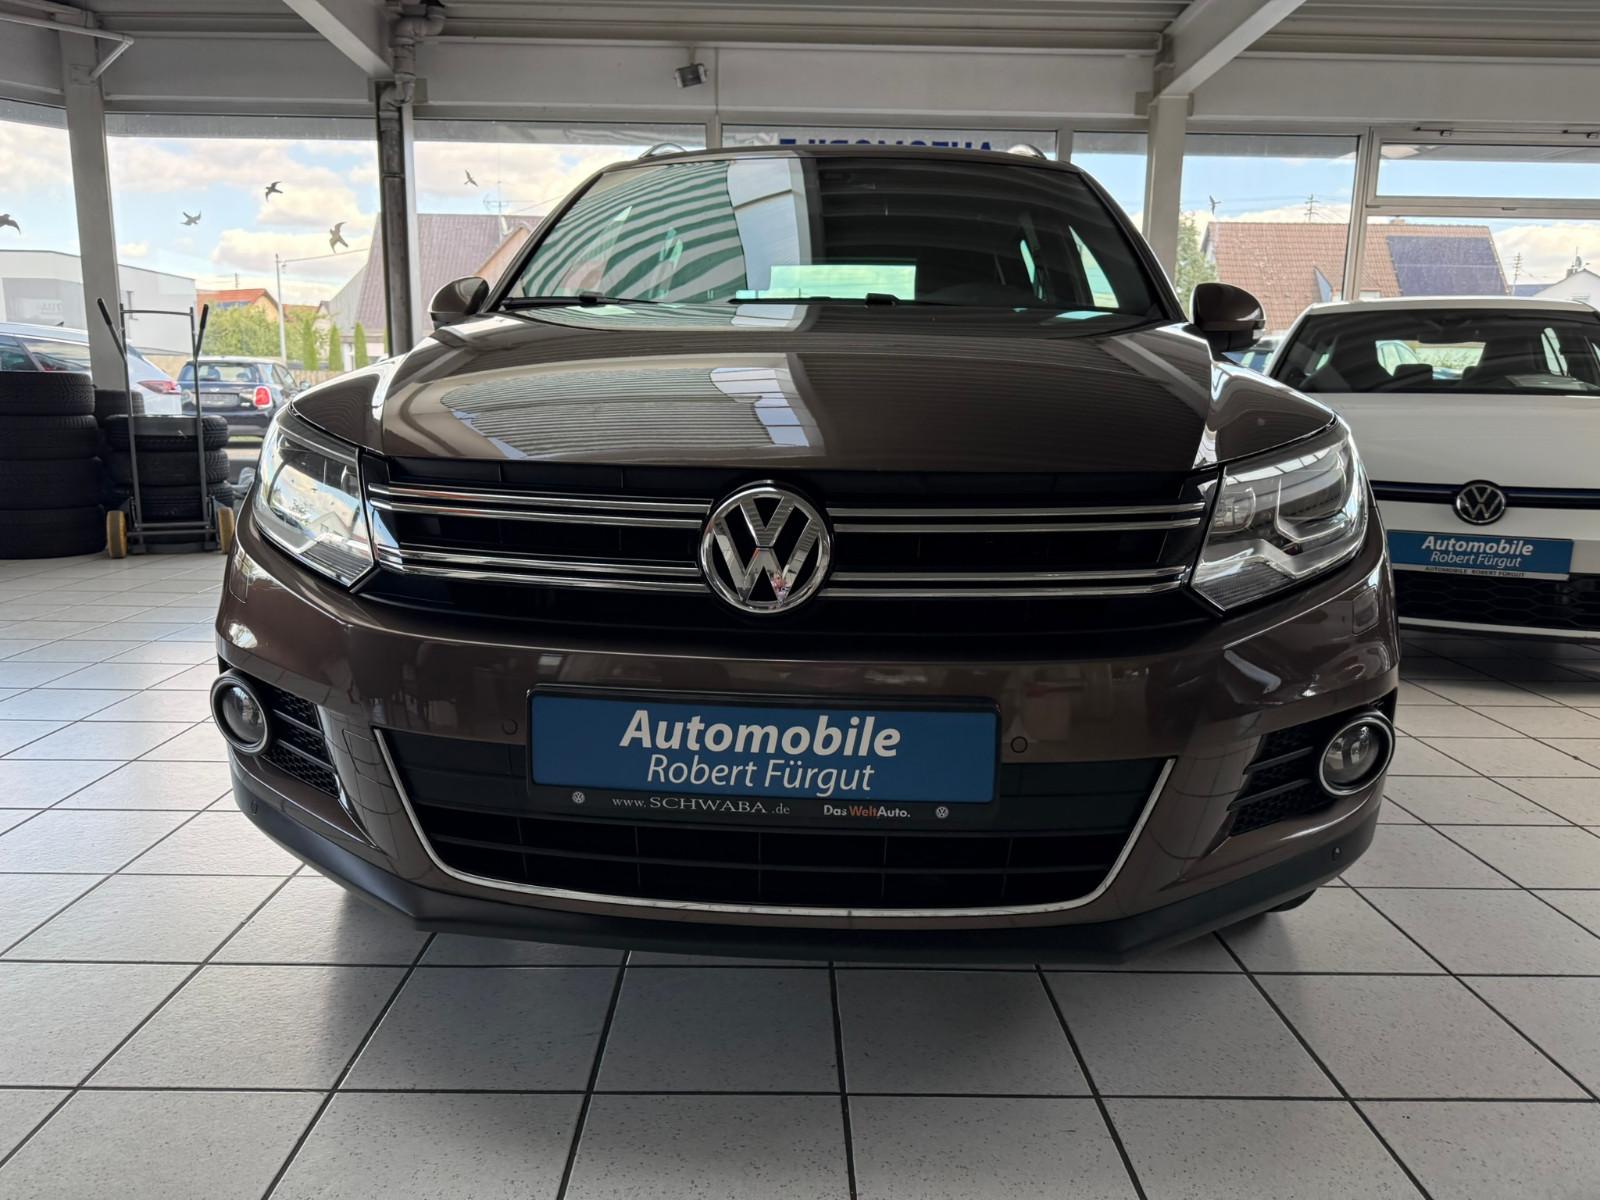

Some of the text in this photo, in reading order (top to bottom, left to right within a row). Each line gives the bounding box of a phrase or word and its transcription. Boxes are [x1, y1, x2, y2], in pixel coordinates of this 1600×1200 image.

[701, 485, 830, 613] VW
[1422, 536, 1533, 555] Automobile
[1431, 551, 1522, 569] Robert Fürgut
[620, 709, 900, 757] Automobile
[648, 754, 875, 798] Robert Fürgut
[823, 804, 847, 816] Das
